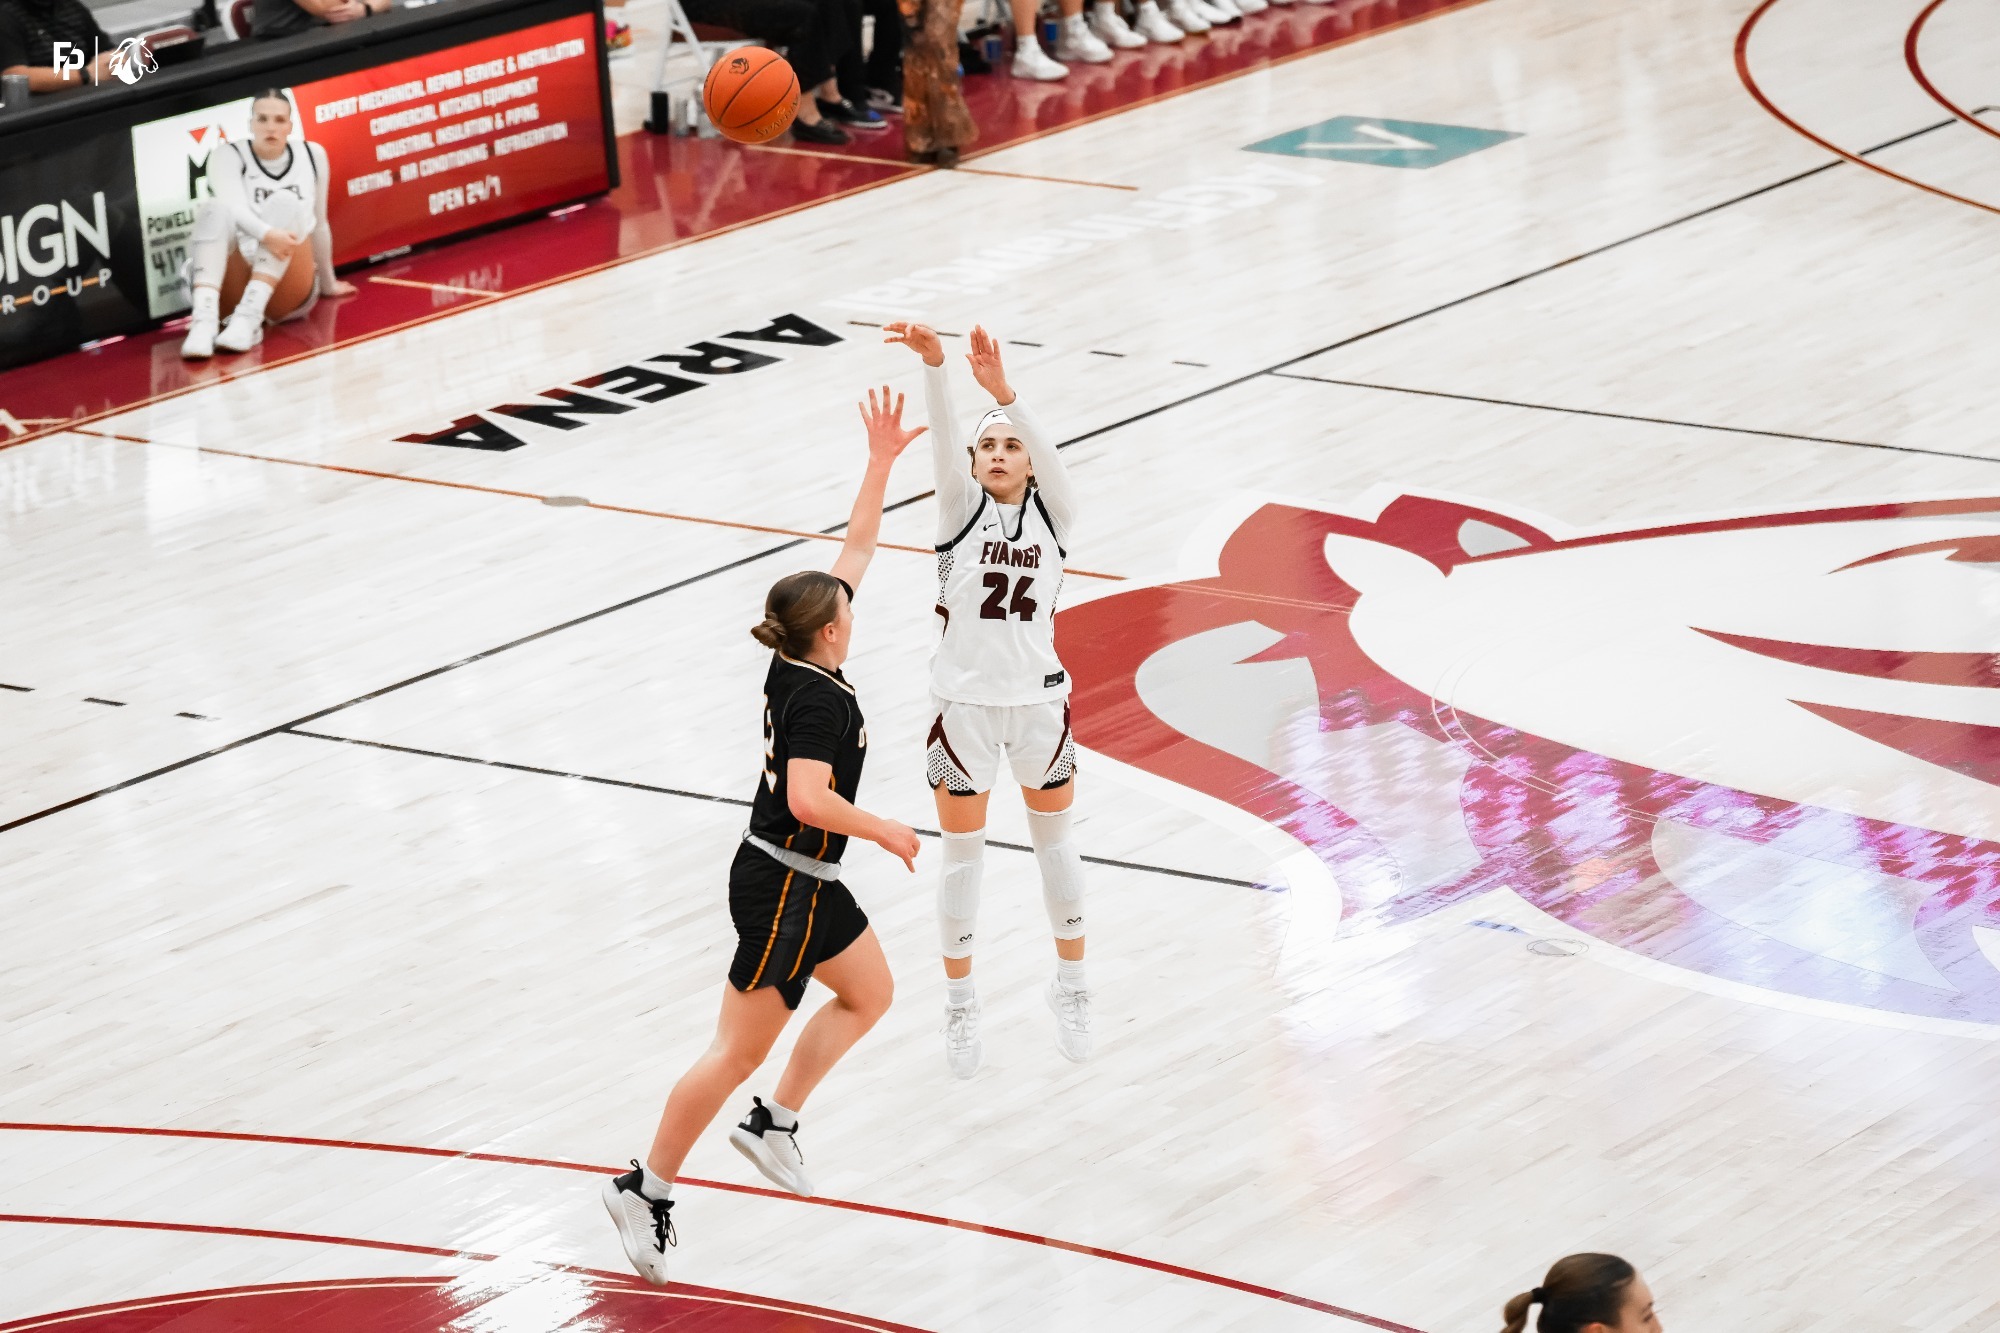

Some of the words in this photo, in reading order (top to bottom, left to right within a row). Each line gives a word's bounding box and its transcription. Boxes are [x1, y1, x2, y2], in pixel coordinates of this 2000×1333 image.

[315, 96, 358, 124] EXPERT
[358, 79, 426, 112] MECHANICAL
[426, 69, 464, 95] REPAIR
[463, 58, 506, 85] SERVICE
[506, 55, 517, 75] &
[517, 37, 585, 71] INSTALLATION
[370, 103, 438, 136] COMMERCIAL
[439, 91, 482, 118] KITCHEN
[482, 76, 539, 108] EQUIPMENT
[347, 169, 393, 197] HEATING
[400, 162, 419, 183] AIR
[419, 143, 489, 178] CONDITIONING
[494, 121, 568, 156] REFRIGERATION
[375, 132, 435, 162] INDUSTRIAL
[435, 115, 493, 146] INSULATION
[494, 112, 505, 131] &
[505, 102, 540, 127] PIPING
[428, 186, 465, 215] OPEN
[465, 174, 501, 206] 24/7
[0, 191, 111, 285] IGN
[391, 312, 846, 453] ARENA
[979, 540, 1042, 569] EVANGE
[979, 571, 1038, 622] 24
